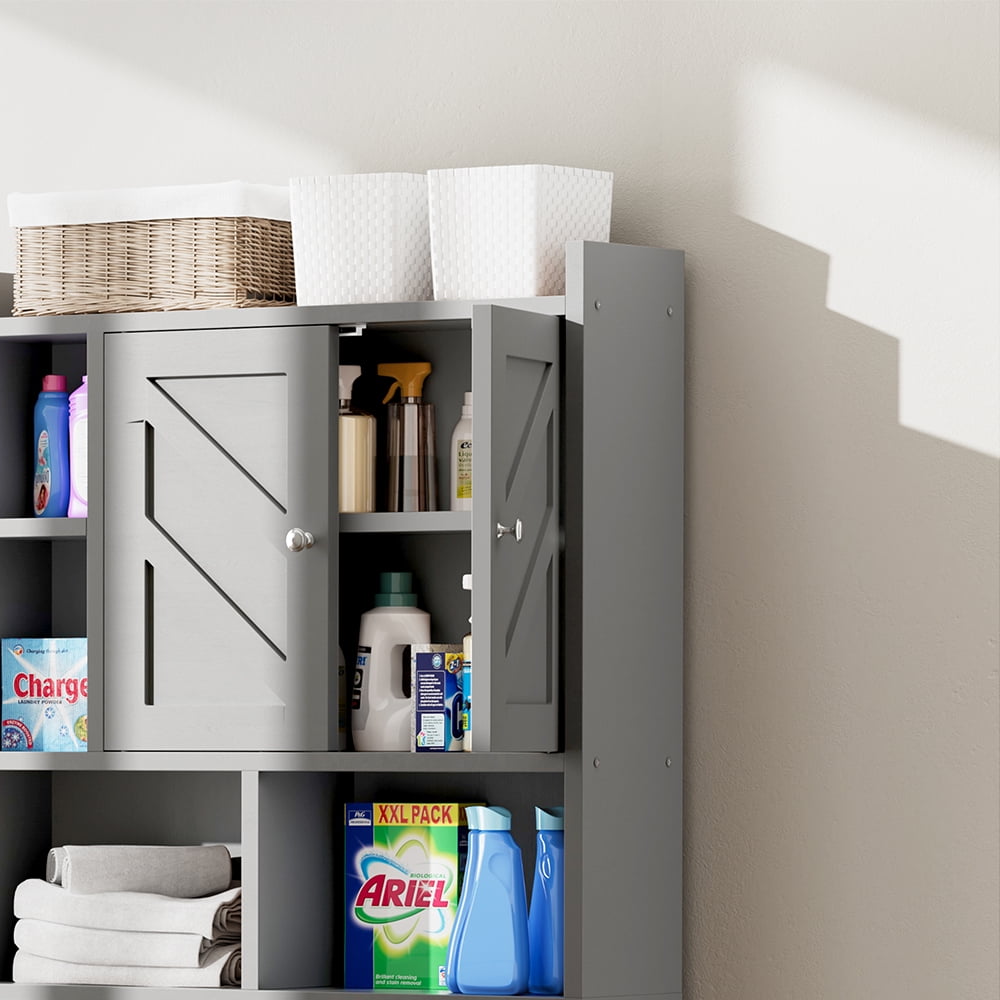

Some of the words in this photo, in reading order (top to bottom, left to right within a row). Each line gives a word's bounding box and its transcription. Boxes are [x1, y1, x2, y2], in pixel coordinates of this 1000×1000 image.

[13, 673, 88, 704] Charge
[378, 805, 408, 824] XXL
[411, 805, 453, 824] PACK
[355, 874, 449, 907] ARIEL
